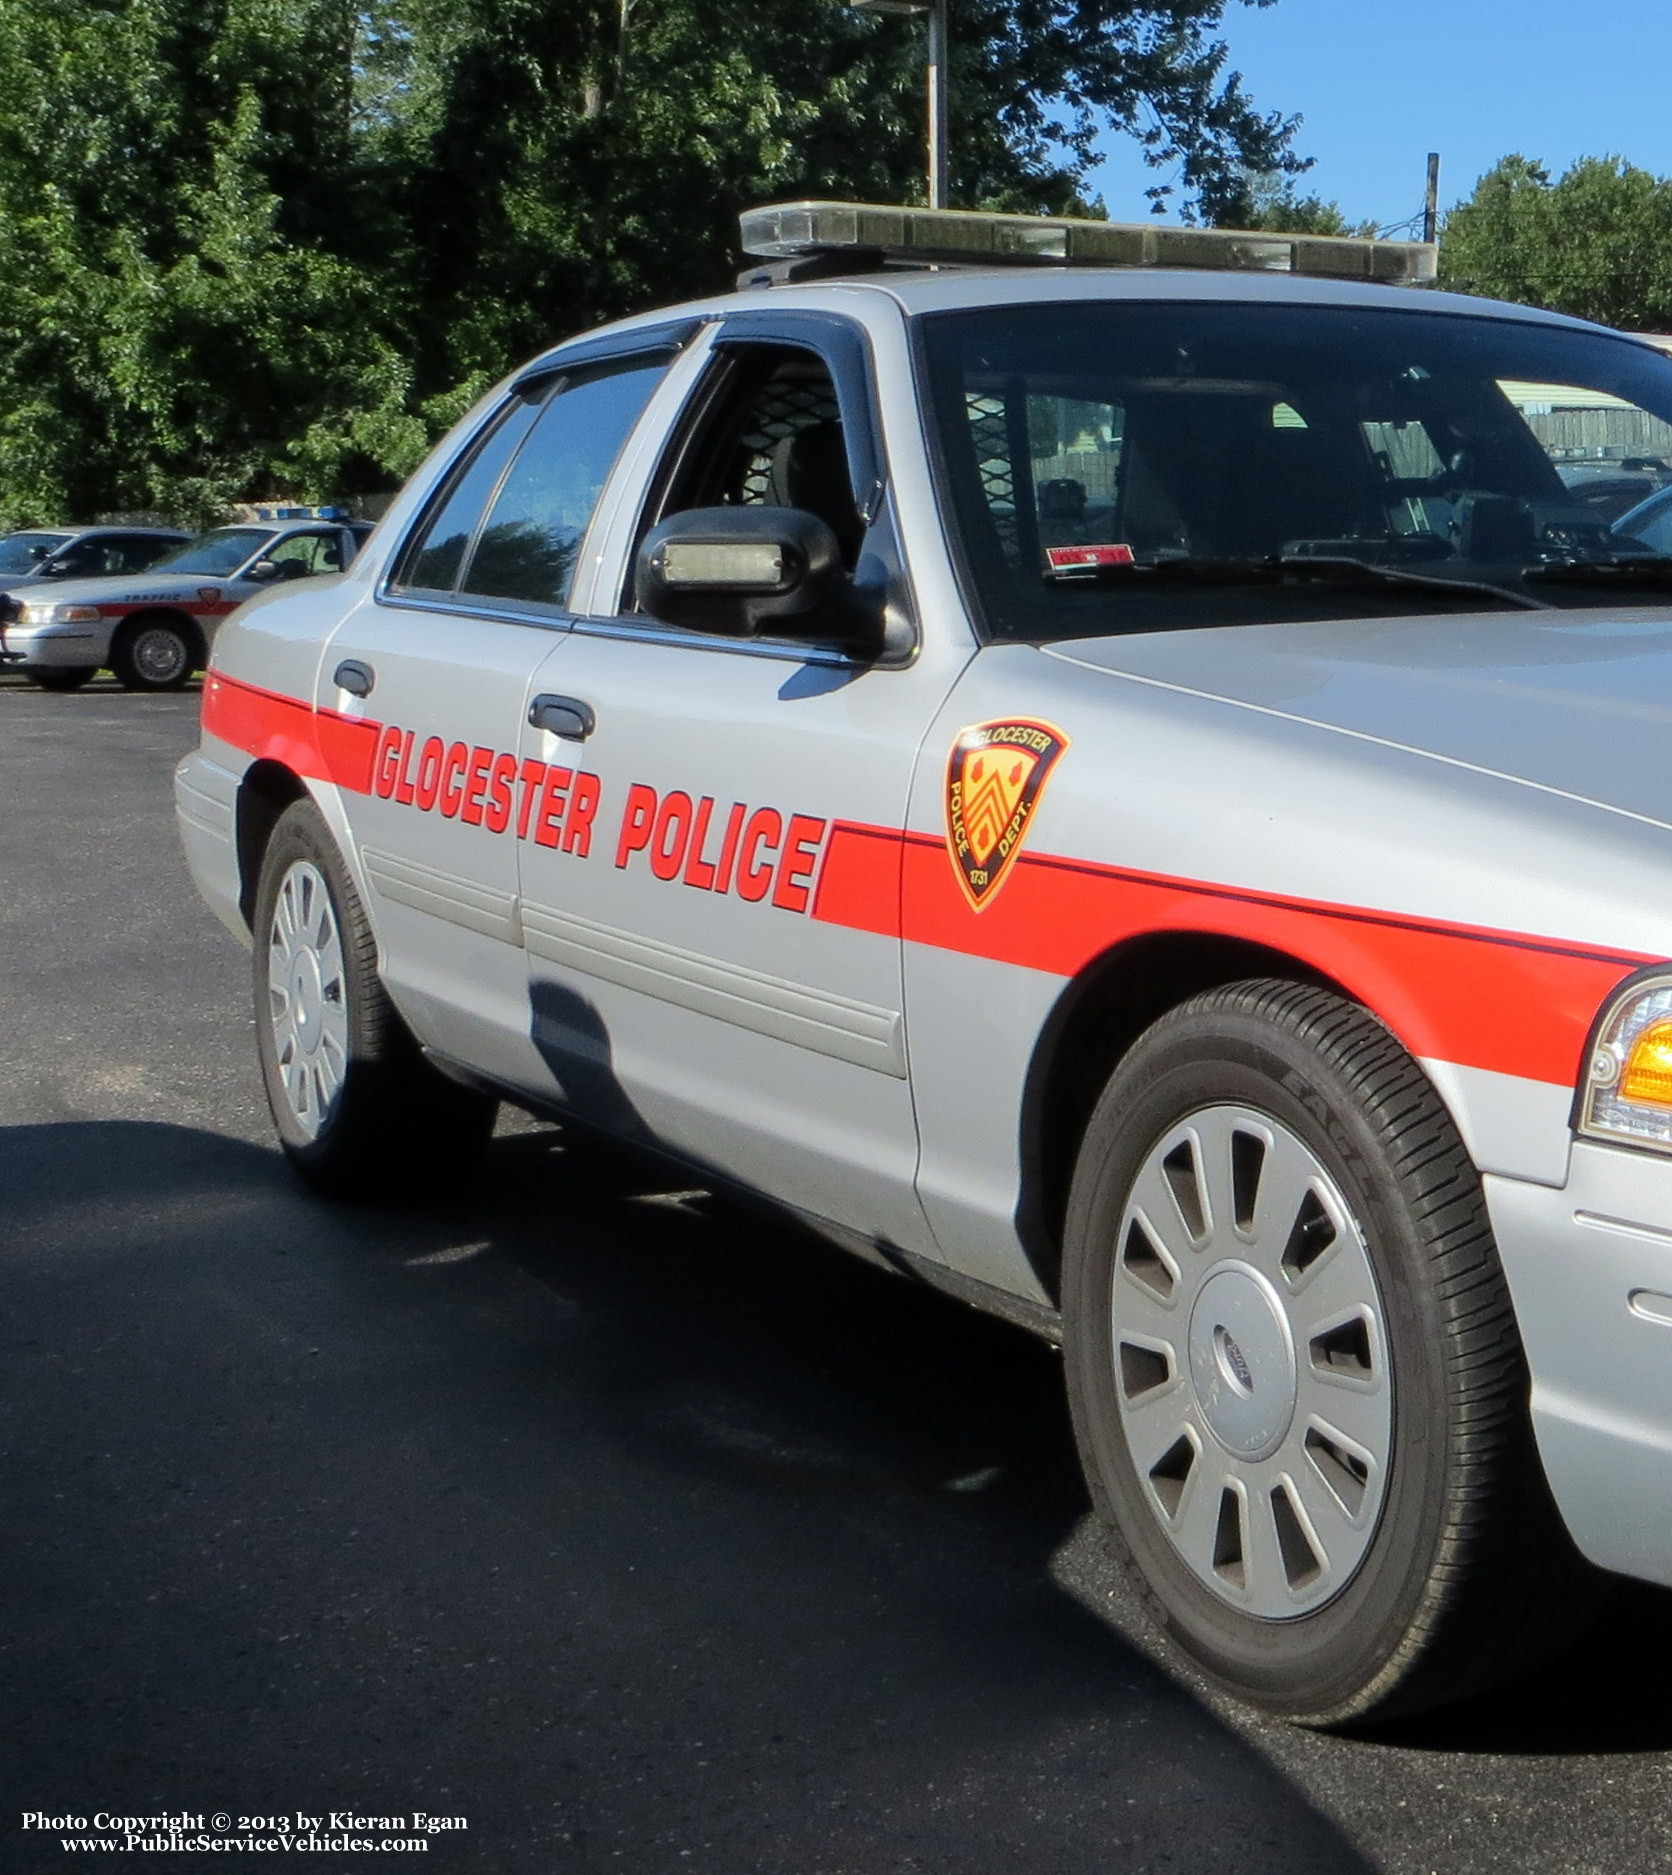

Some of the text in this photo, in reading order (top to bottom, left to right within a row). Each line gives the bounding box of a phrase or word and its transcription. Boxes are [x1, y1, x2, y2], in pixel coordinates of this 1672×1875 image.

[975, 726, 1052, 753] GLOCESTER
[376, 726, 826, 914] GLOCESTER POLICE
[950, 782, 970, 857] POLICE
[999, 801, 1032, 857] DEPT.
[969, 870, 988, 885] 1731
